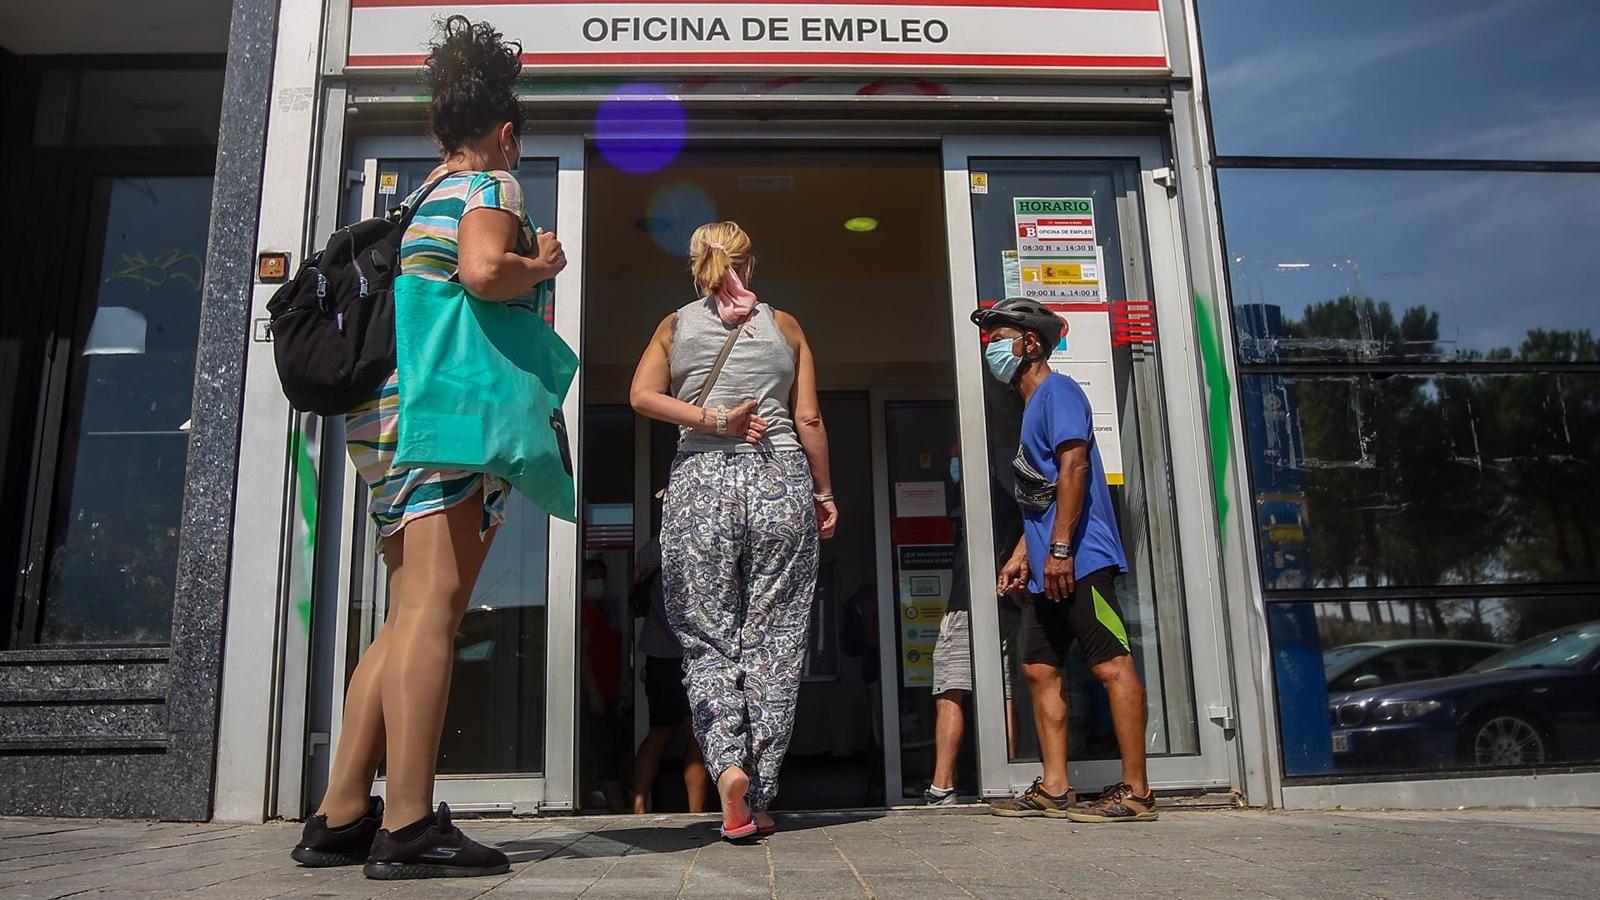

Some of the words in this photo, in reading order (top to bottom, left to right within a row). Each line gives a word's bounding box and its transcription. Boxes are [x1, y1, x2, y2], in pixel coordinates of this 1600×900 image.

[582, 17, 730, 42] OFICINA
[742, 18, 790, 42] DE
[801, 18, 949, 43] EMPLEO
[1020, 201, 1089, 211] HORARIO
[1026, 227, 1036, 237] B
[1032, 271, 1038, 281] 1
